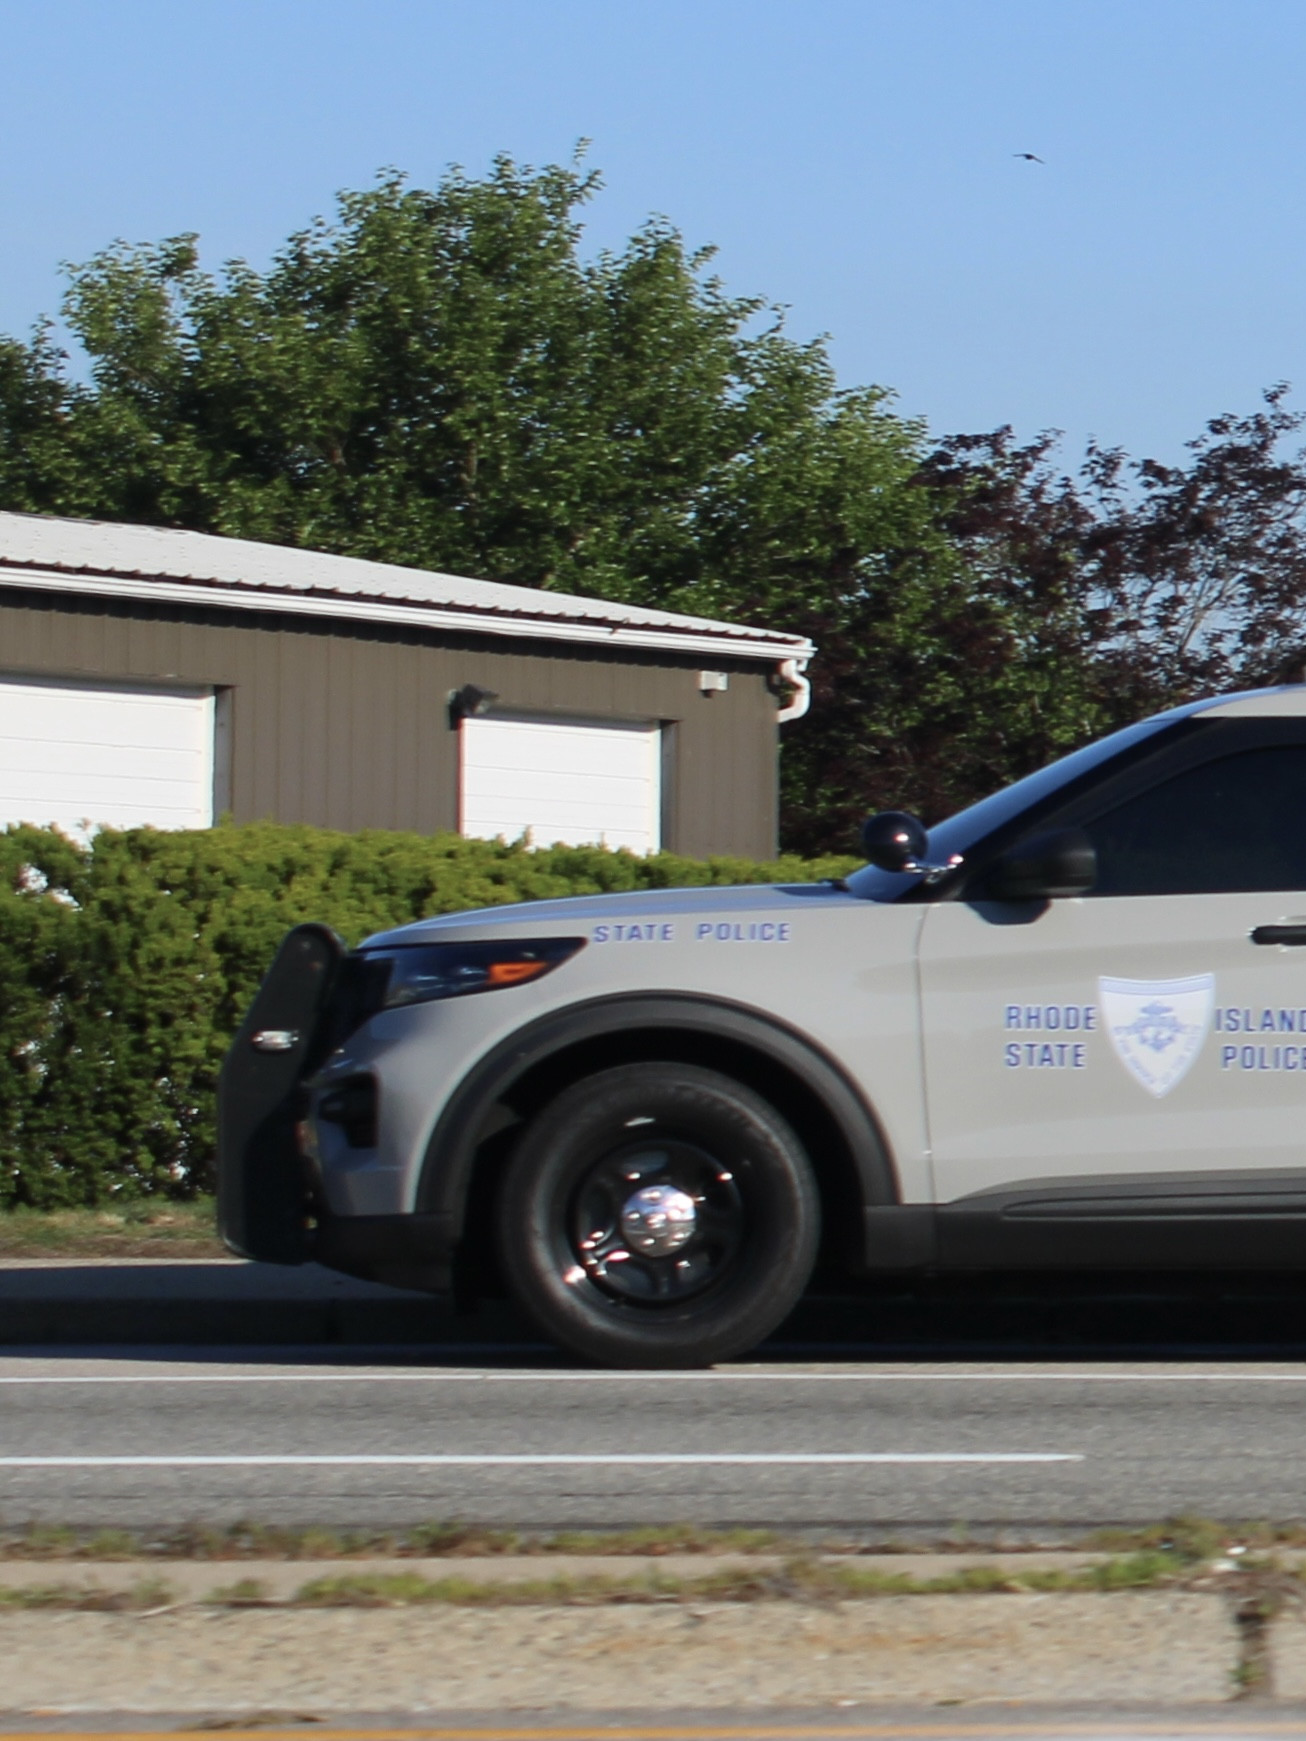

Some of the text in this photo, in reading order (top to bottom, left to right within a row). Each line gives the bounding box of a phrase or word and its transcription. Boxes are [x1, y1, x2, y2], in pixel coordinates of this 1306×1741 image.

[593, 922, 791, 943] STATE POLICE
[1005, 1006, 1096, 1030] RHODE
[1005, 1043, 1086, 1067] STATE
